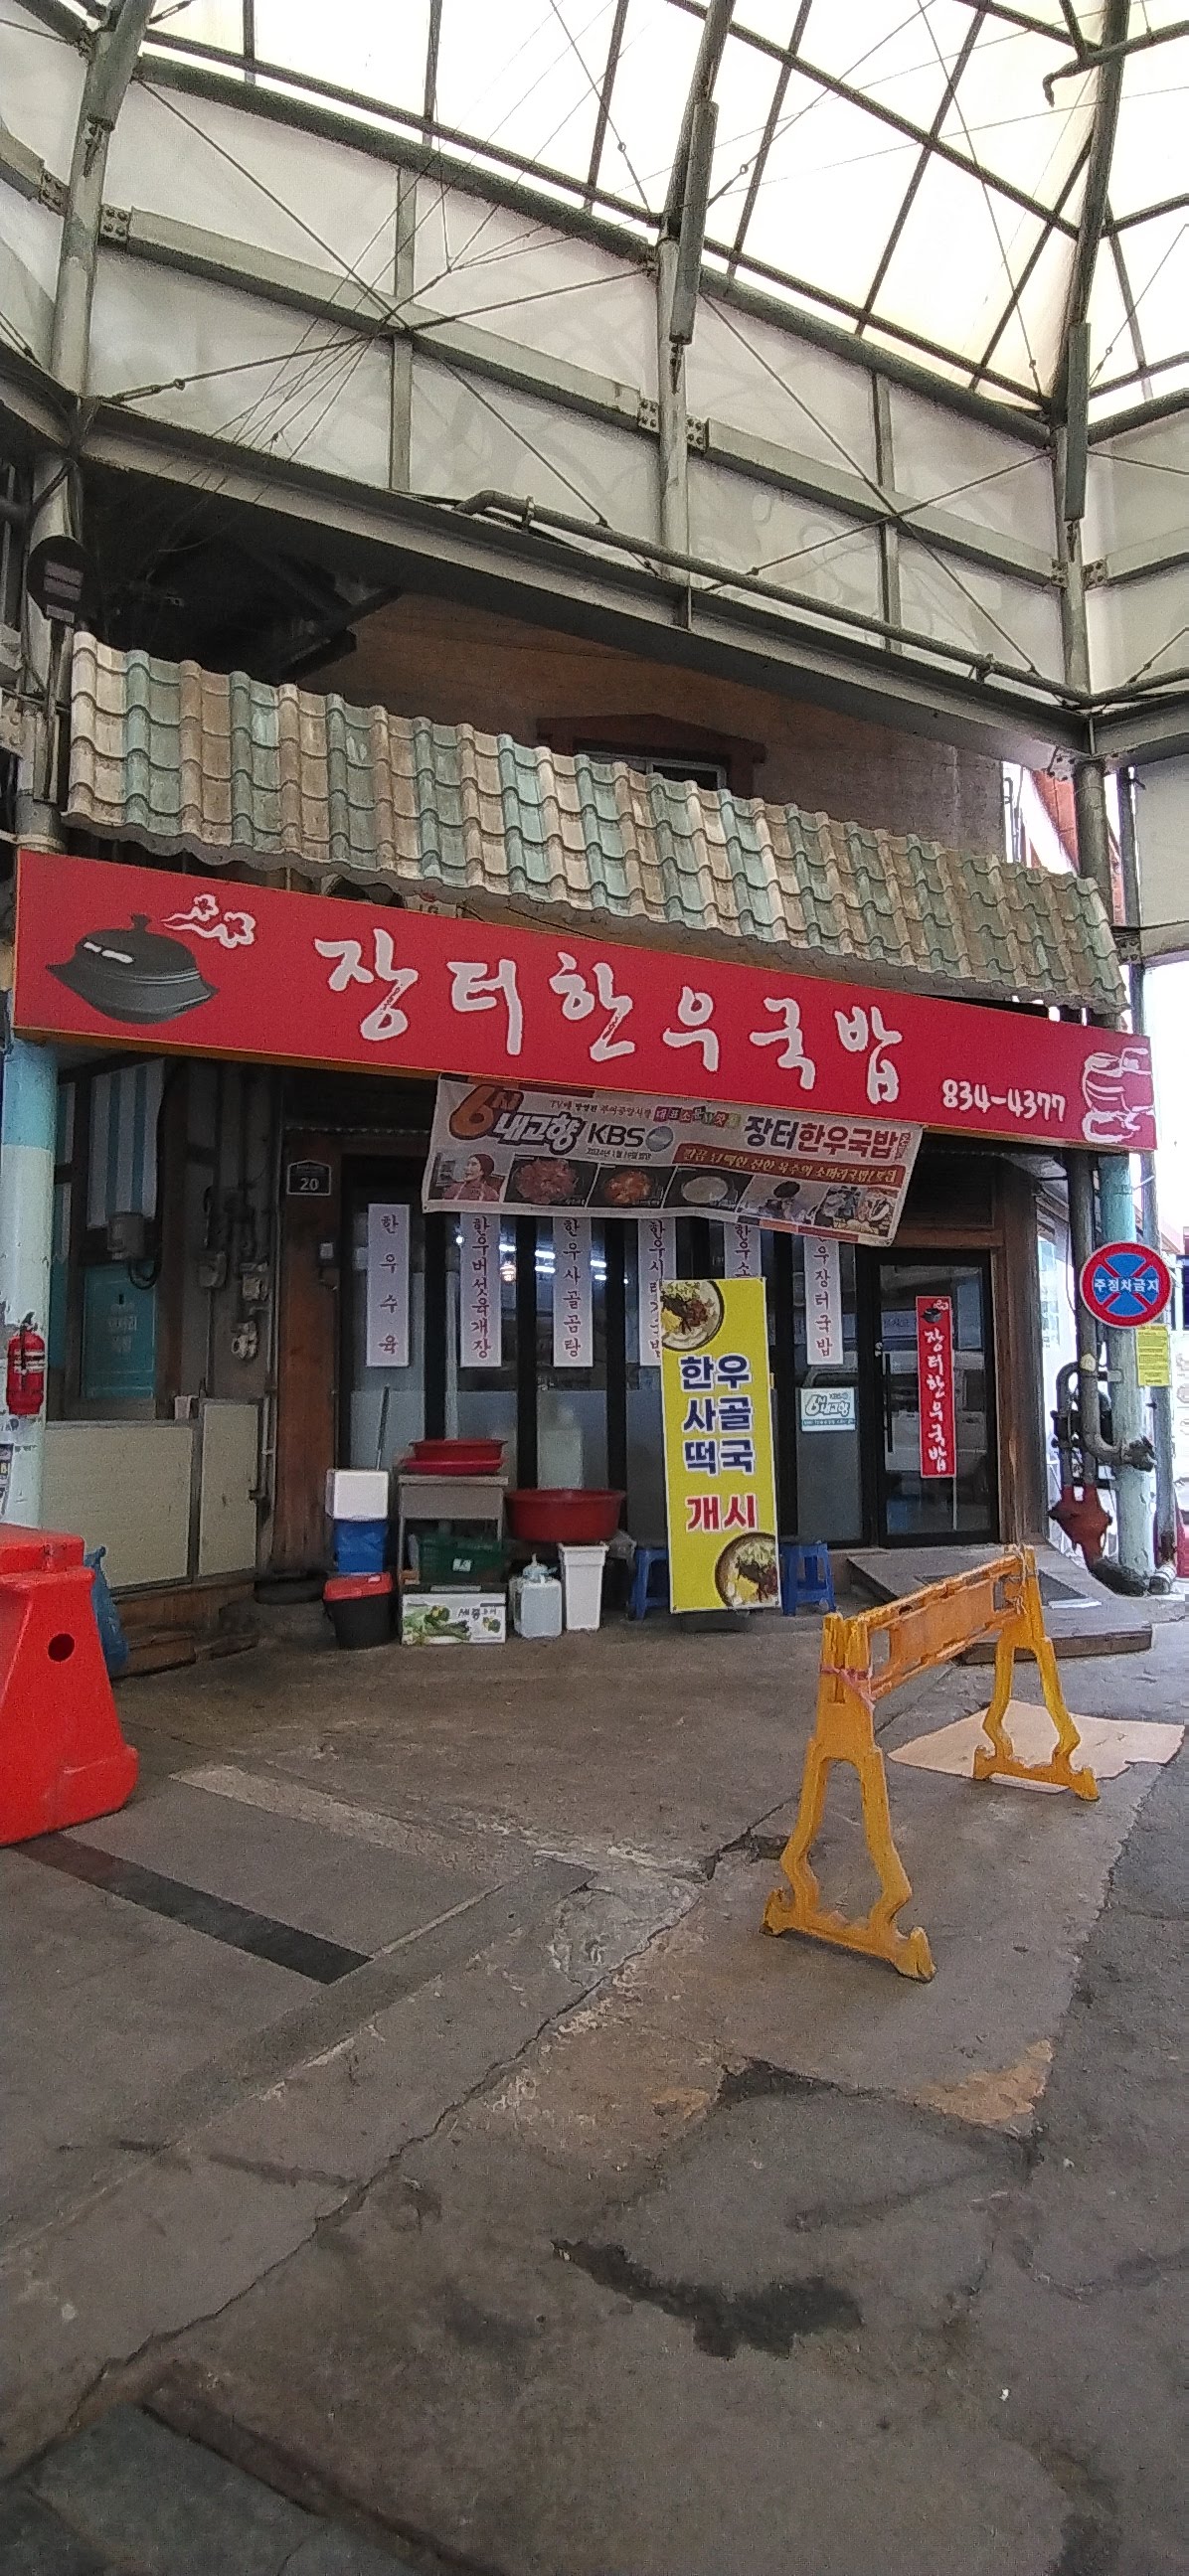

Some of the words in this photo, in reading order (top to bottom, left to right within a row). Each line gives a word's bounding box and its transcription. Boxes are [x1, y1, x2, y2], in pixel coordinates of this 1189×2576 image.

[313, 927, 905, 1105] 장터한우국밥
[942, 1078, 1067, 1122] 834-4377
[491, 1112, 588, 1156] 내고향
[588, 1122, 646, 1147] KBS
[745, 1115, 900, 1160] 장터한우국밥
[299, 1176, 320, 1192] 20
[562, 1217, 582, 1359] 한우사골곰탕
[813, 1237, 833, 1358] 우장터국밥
[1094, 1277, 1160, 1293] 주정차금지
[679, 1354, 752, 1391] 한우
[682, 1395, 753, 1433] 사골
[923, 1327, 948, 1474] 장터한우국밥
[684, 1438, 755, 1476] 떡국
[686, 1494, 757, 1531] 개시
